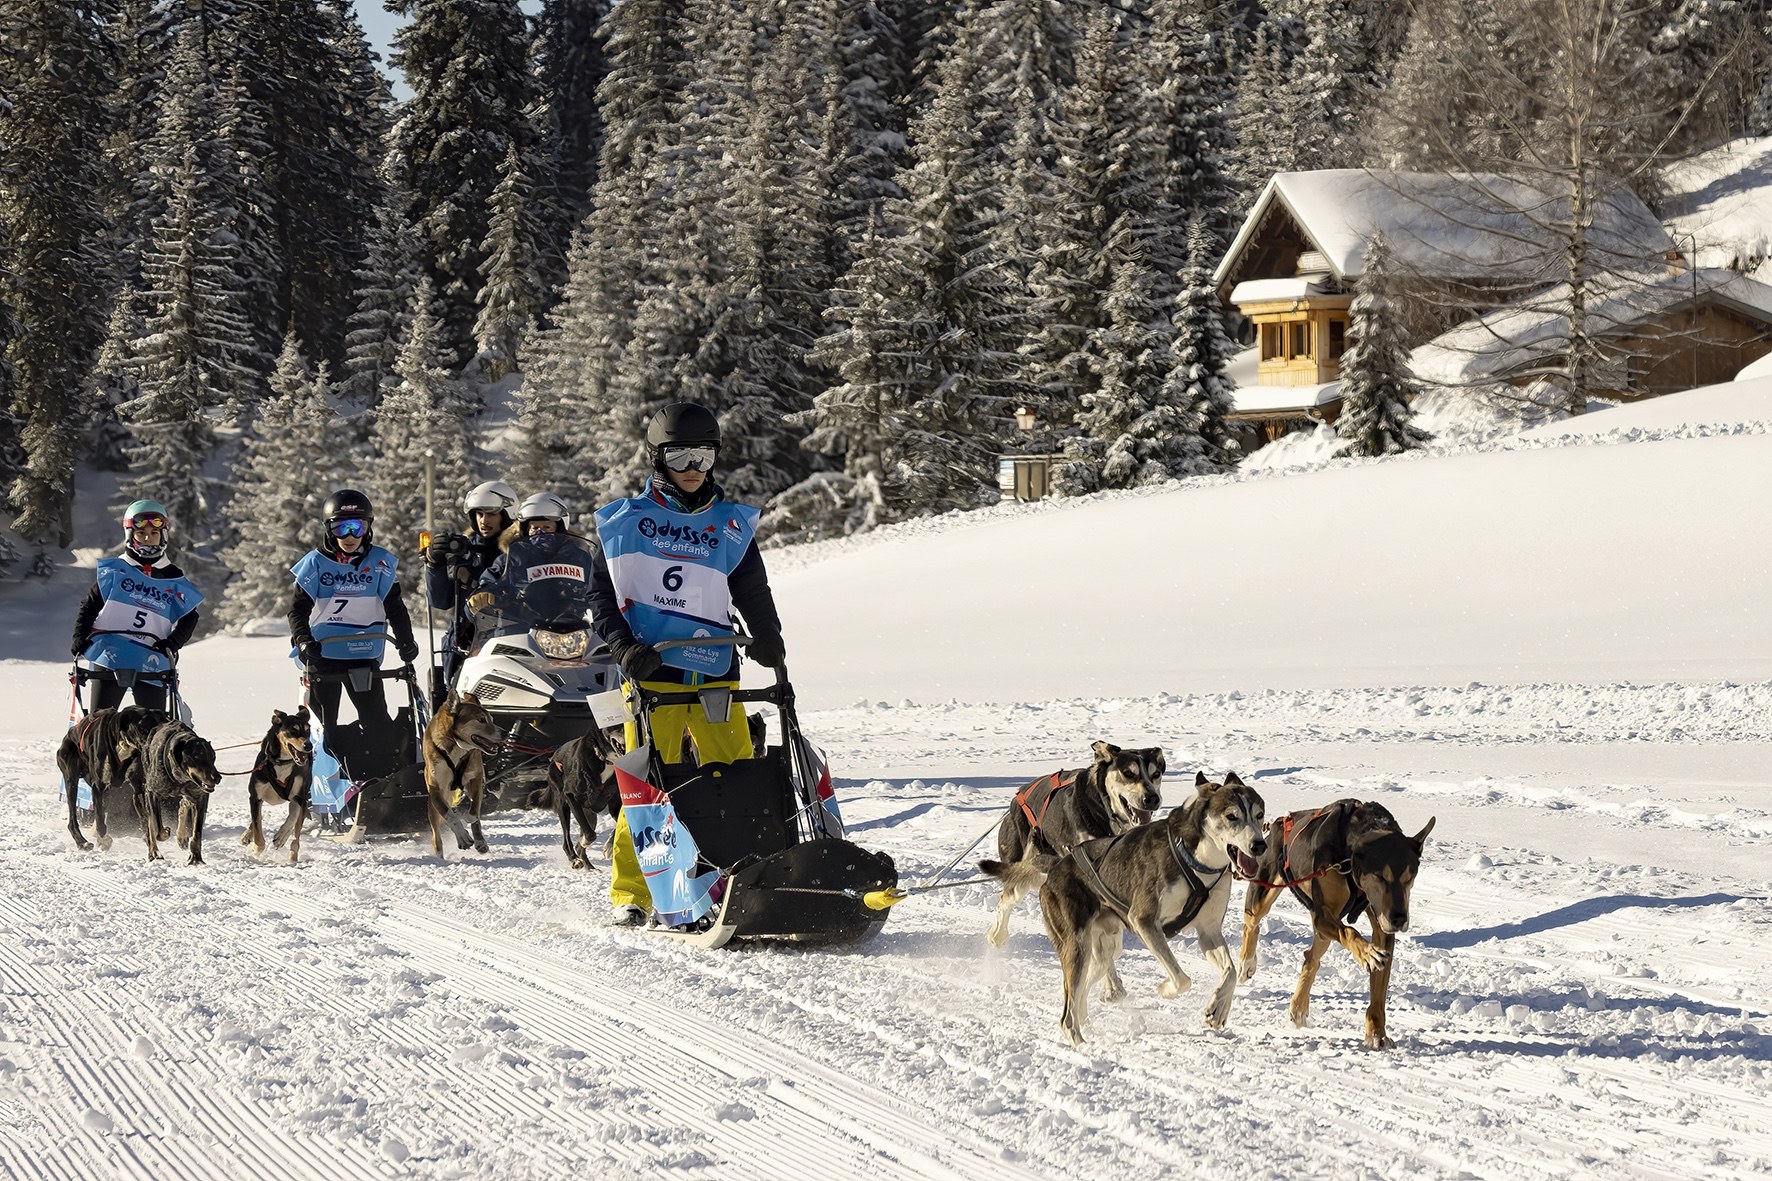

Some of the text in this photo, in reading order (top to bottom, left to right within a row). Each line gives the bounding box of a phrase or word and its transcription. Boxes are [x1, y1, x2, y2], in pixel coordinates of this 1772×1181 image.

[652, 537, 710, 557] des enfants
[542, 565, 582, 578] YAMAHA
[662, 565, 683, 592] 6
[332, 599, 349, 615] 7
[653, 593, 687, 609] MAXIME
[133, 610, 148, 629] 5
[682, 650, 717, 664] Sommand
[707, 648, 720, 658] Lys
[623, 792, 642, 800] BLANC
